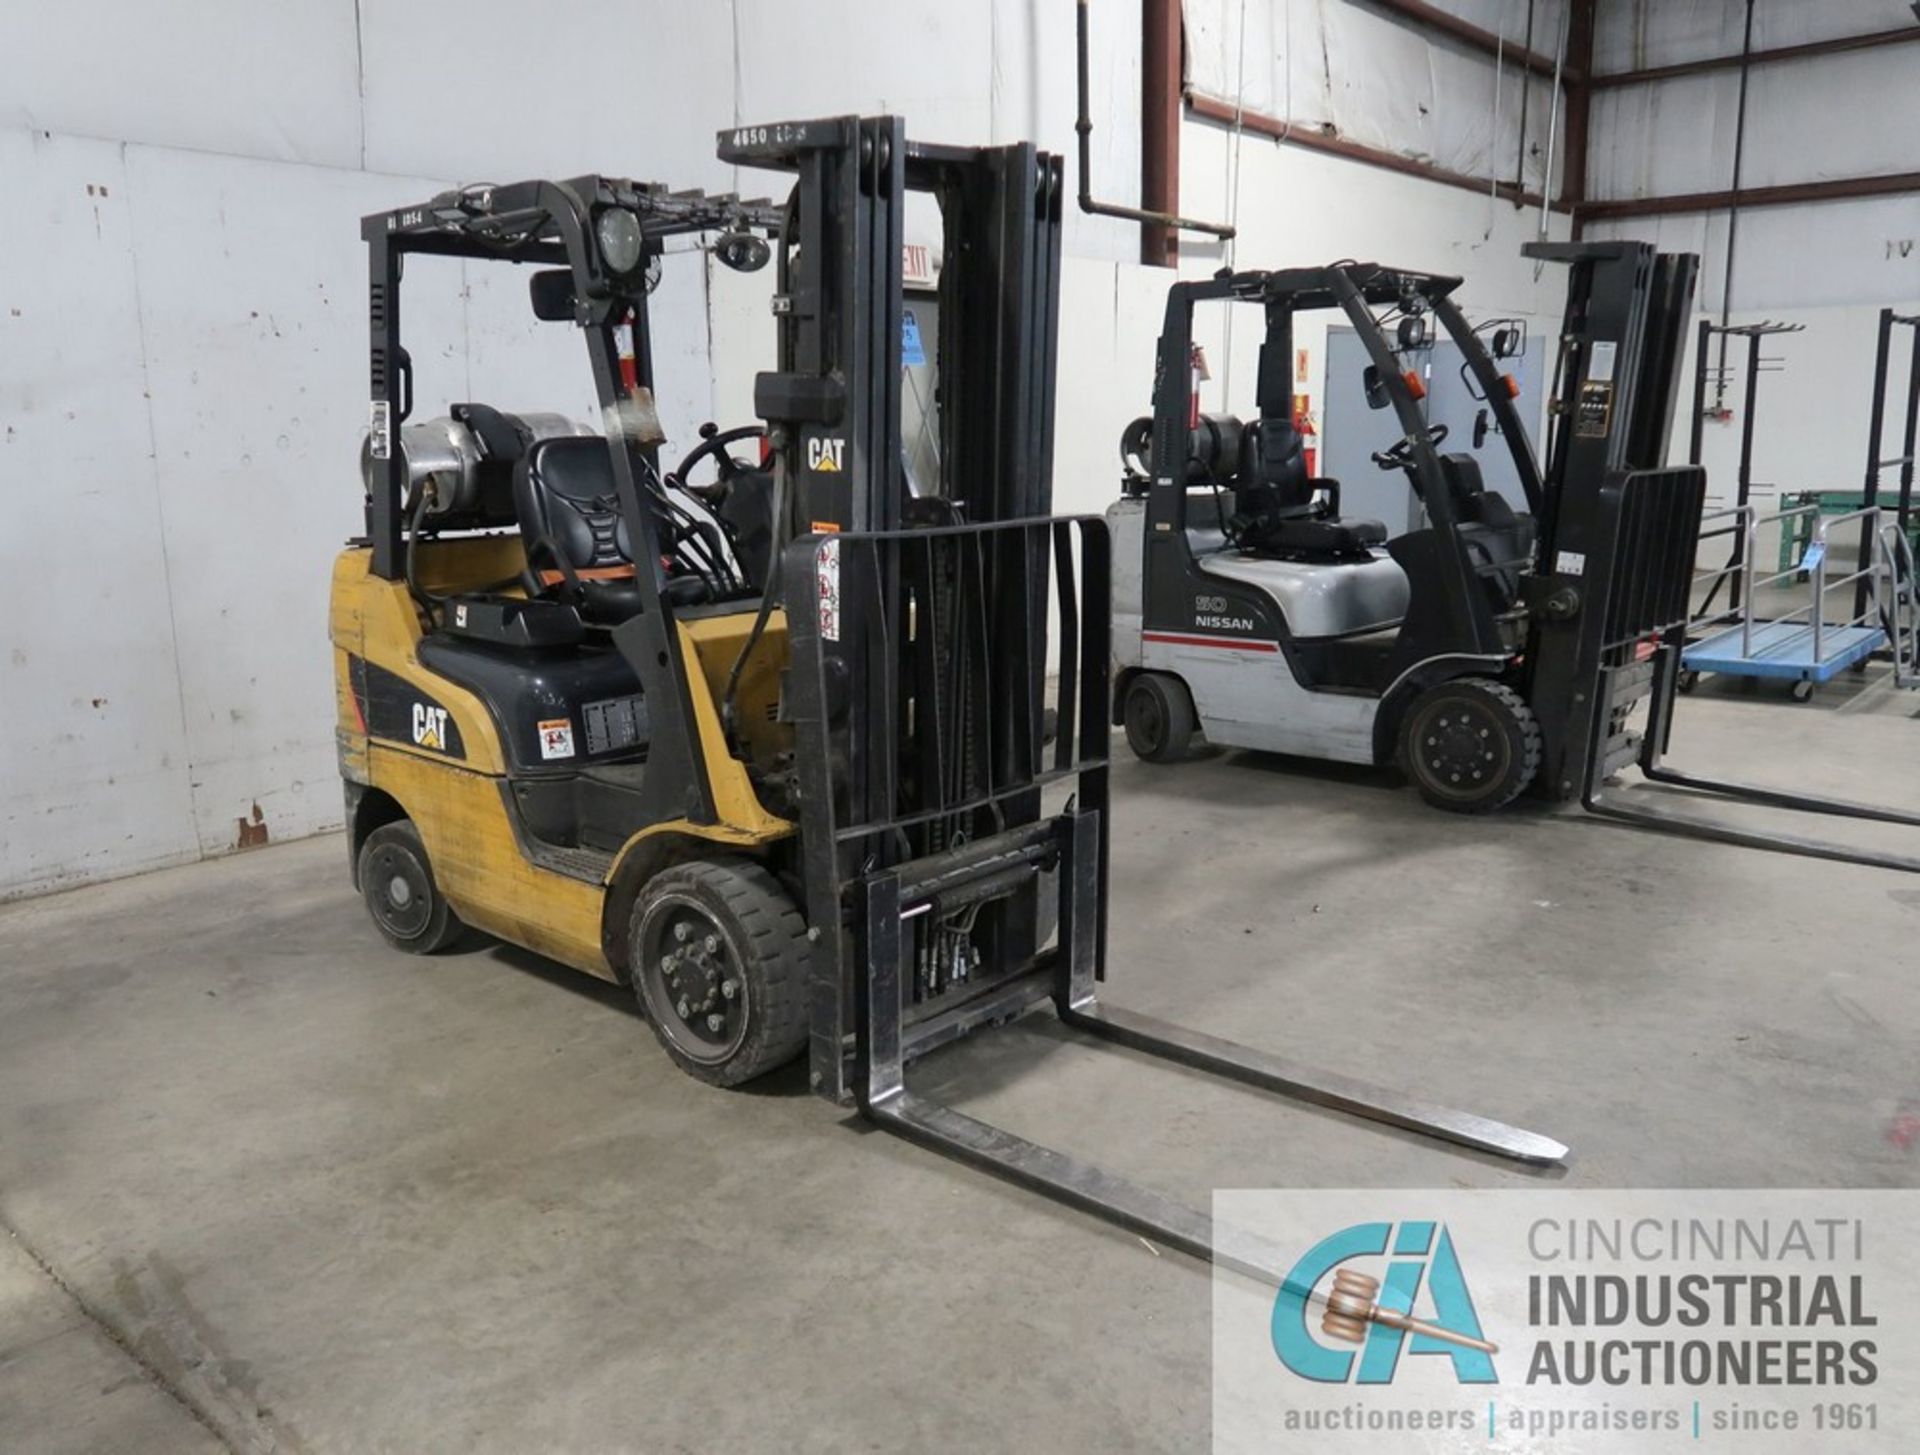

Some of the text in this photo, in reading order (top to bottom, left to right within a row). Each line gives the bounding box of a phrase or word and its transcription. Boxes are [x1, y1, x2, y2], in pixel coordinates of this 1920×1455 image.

[808, 437, 846, 472] CAT
[1195, 595, 1227, 613] 50
[1195, 615, 1253, 630] NISSAN
[412, 702, 448, 751] CAT
